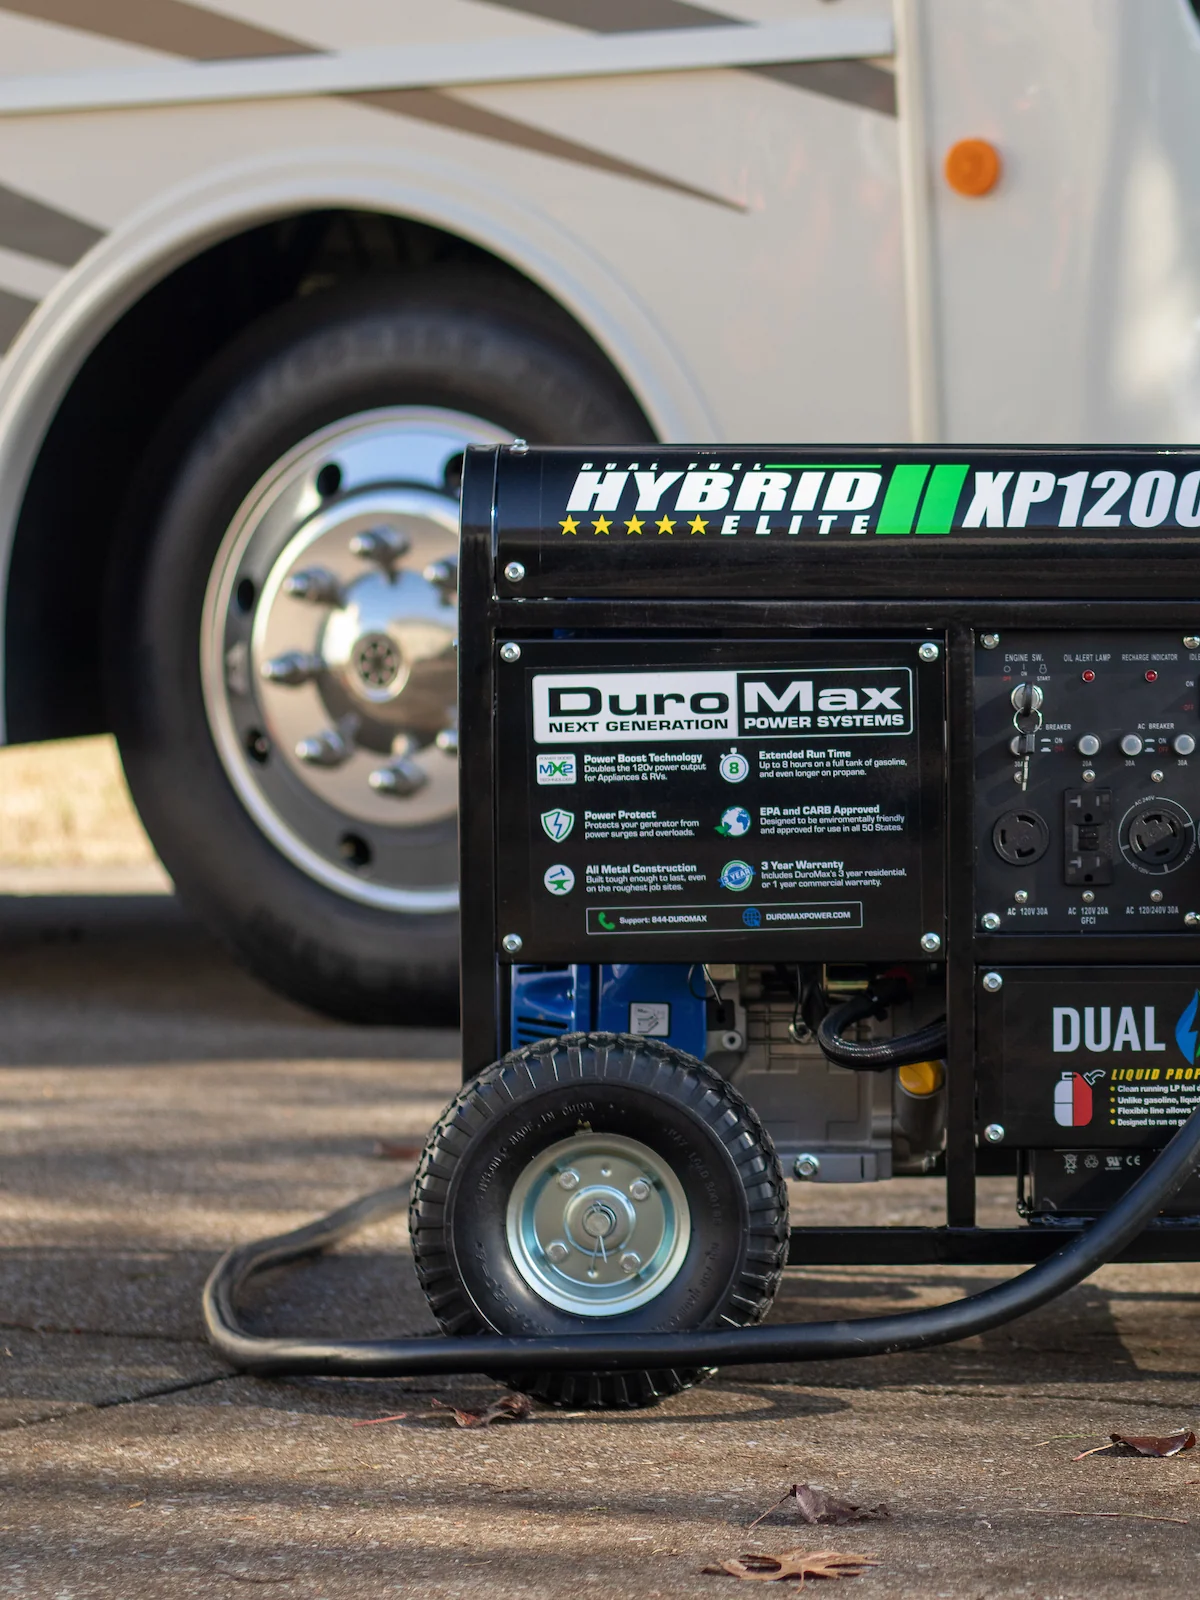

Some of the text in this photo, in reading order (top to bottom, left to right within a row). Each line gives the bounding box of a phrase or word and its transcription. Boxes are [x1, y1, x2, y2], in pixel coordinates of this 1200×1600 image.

[566, 472, 882, 512] HYBRID
[720, 516, 871, 534] ELITE
[549, 718, 728, 733] NEXT GENERATION
[744, 714, 904, 730] POWER SYSTEMS
[584, 753, 702, 764] Power Boost Technology
[759, 749, 851, 759] Extended Run Time
[539, 762, 573, 776] MX2
[584, 764, 615, 772] Doubles
[681, 762, 706, 772] output
[729, 762, 739, 774] 8
[759, 760, 770, 770] Up
[598, 773, 639, 783] Appliances
[795, 768, 820, 778] longer
[833, 769, 866, 777] propane.
[585, 810, 656, 819] Power Protect
[760, 805, 879, 816] EPA and CARB Approved
[585, 821, 619, 829] Protects
[640, 819, 679, 829] generator
[760, 816, 796, 826] Designed
[876, 814, 904, 824] friendly
[655, 828, 694, 836] overloads.
[777, 825, 812, 835] approved
[875, 823, 902, 831] States.
[586, 864, 696, 874] All Metal Construction
[761, 860, 843, 871] 3 Year Warranty
[730, 868, 750, 880] YEAR
[762, 871, 793, 879] Includes
[605, 875, 628, 885] tough
[630, 874, 658, 884] enough
[670, 874, 686, 883] last,
[799, 879, 843, 887] commercial
[845, 878, 881, 888] warranty.
[613, 883, 648, 893] roughest
[649, 883, 661, 892] job
[620, 916, 650, 925] Support:
[766, 912, 850, 920] DUROMAXPOWER.COM
[1052, 1006, 1166, 1052] DUAL
[1111, 1068, 1160, 1081] LIQUID
[1140, 1085, 1168, 1094] running
[1144, 1096, 1178, 1105] gasoline,
